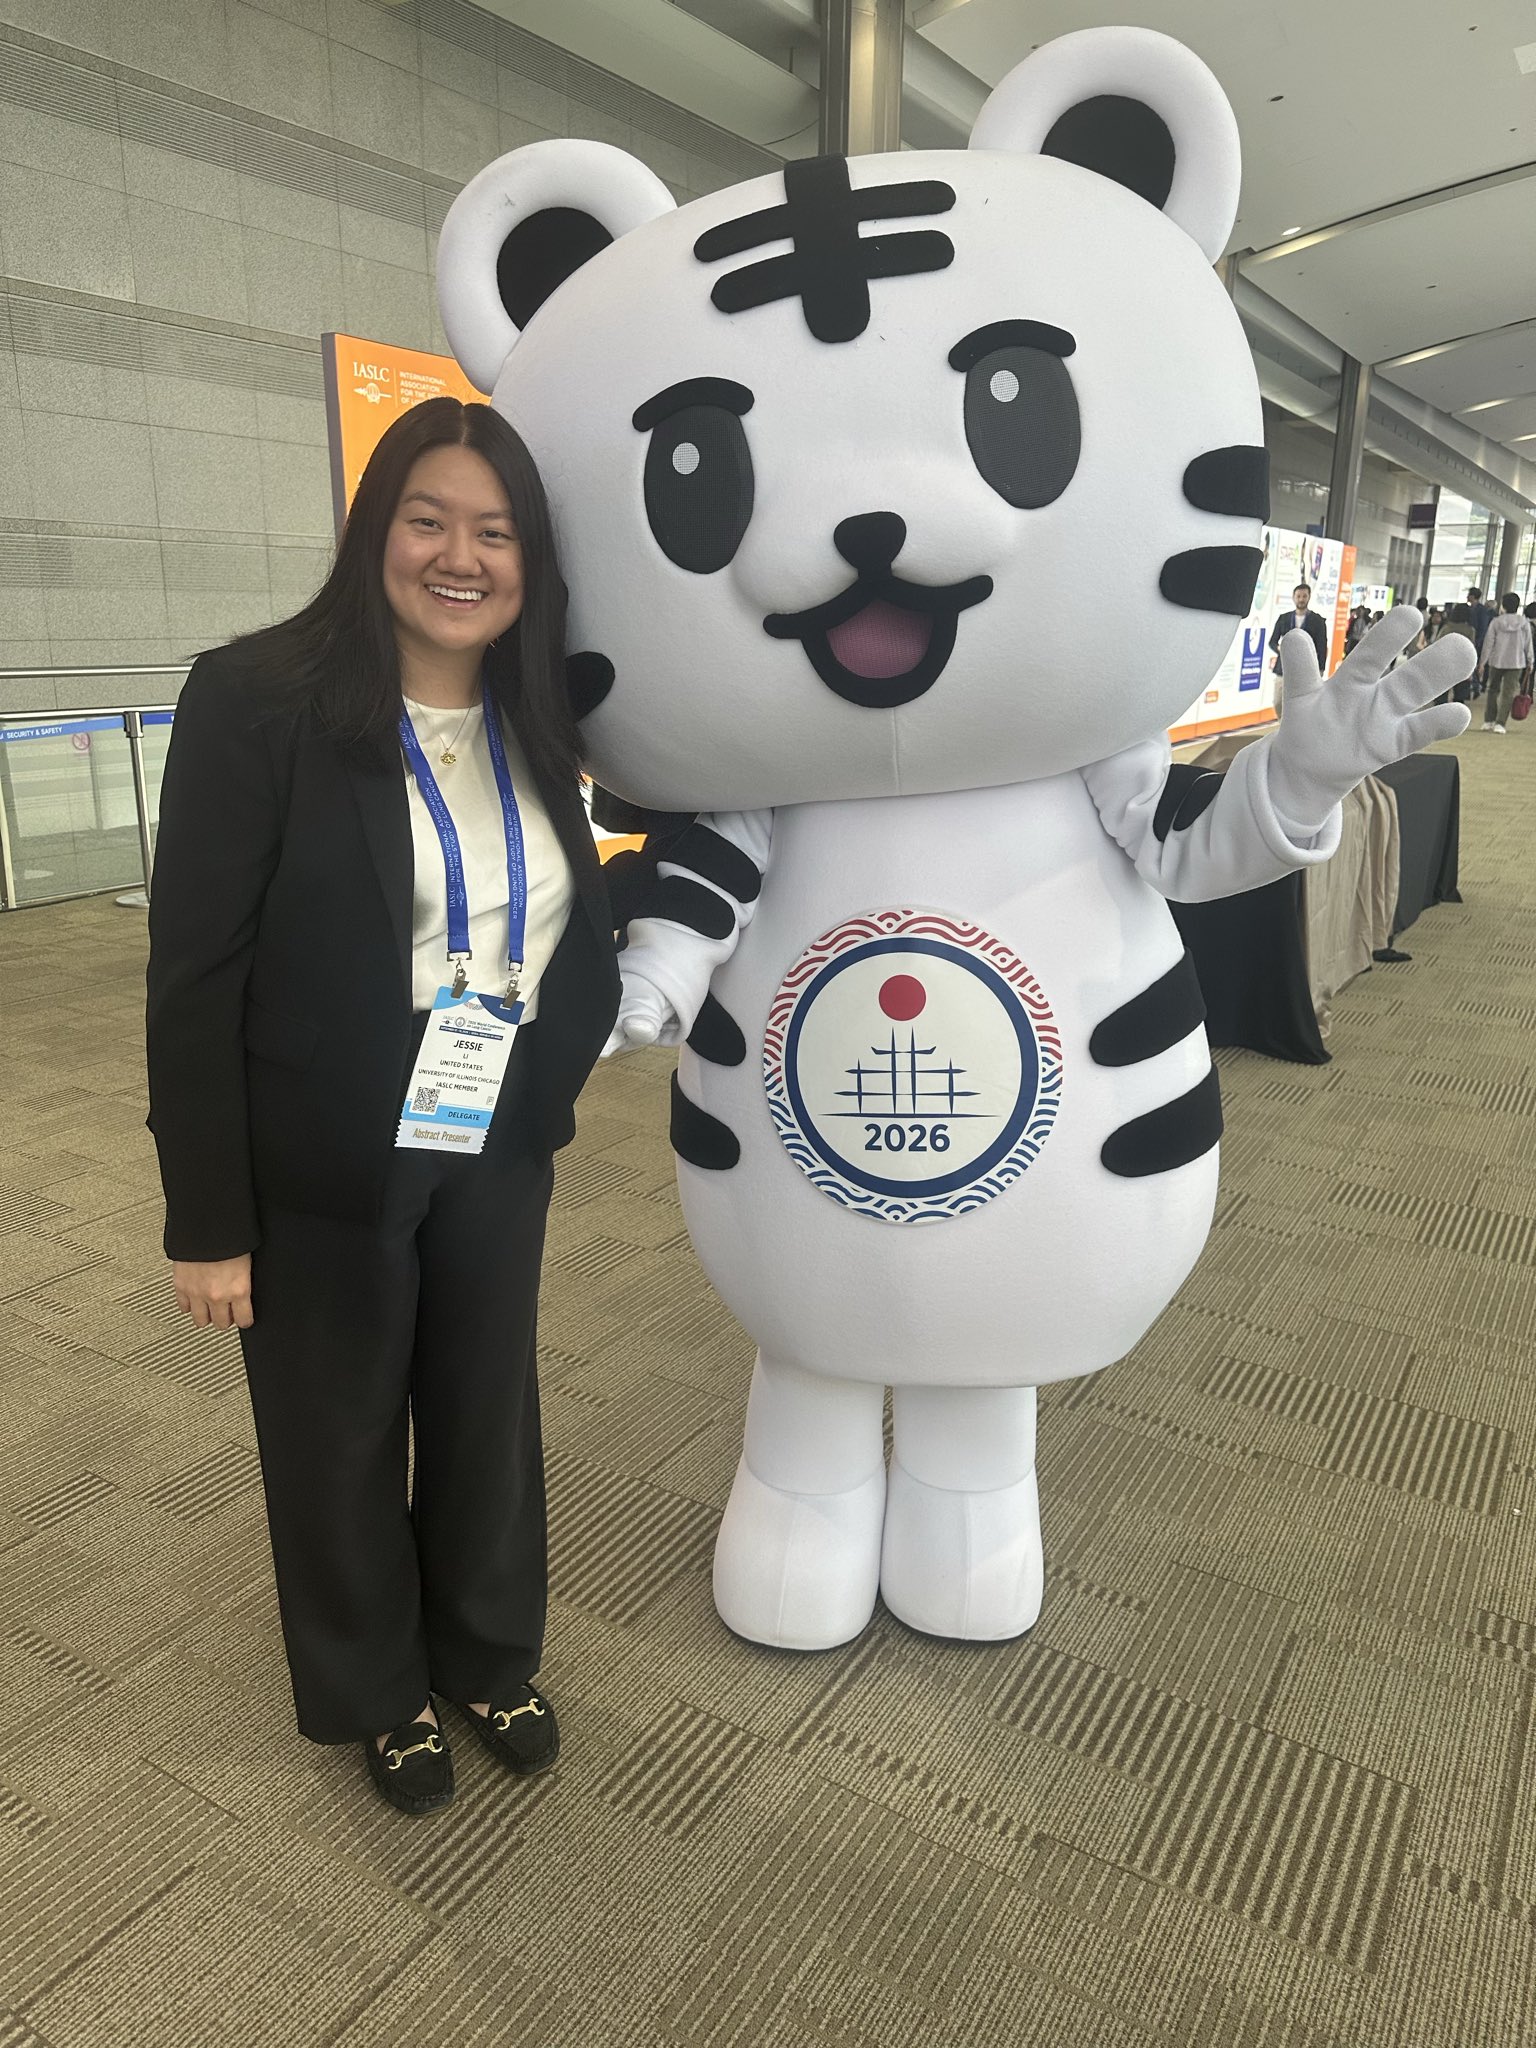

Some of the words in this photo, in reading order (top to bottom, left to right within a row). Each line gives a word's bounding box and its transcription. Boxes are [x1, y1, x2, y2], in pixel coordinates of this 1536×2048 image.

[353, 361, 390, 383] IASLC
[399, 371, 447, 387] INTERNATIONAL
[400, 379, 440, 393] ASSOCIATION
[400, 388, 414, 397] FOR
[415, 390, 426, 399] THE
[400, 396, 410, 405] OF
[6, 729, 34, 739] SECURITY
[41, 726, 63, 735] SAFETY
[426, 776, 440, 801] CANCER
[425, 787, 444, 828] ASSOCIATION
[437, 802, 448, 819] LUNG
[444, 820, 451, 829] OF
[448, 830, 458, 852] STUDY
[512, 813, 522, 862] INTERNATIONAL
[443, 830, 456, 883] INTERNATIONAL
[511, 862, 517, 871] OF
[516, 865, 524, 908] ASSOCIATION
[453, 1039, 484, 1052] JESSIE
[440, 1059, 461, 1068] UNITED
[462, 1062, 484, 1071] STATES
[418, 1068, 448, 1077] UNIVERSITY
[456, 1074, 477, 1082] ILLINOIS
[477, 1077, 500, 1085] CHICAGO
[435, 1081, 453, 1089] IASLC
[453, 1084, 478, 1092] MEMBER
[448, 1111, 480, 1120] DELEGATE
[413, 1128, 441, 1140] Abstract
[441, 1131, 472, 1143] Presenter
[864, 1123, 950, 1152] 2026
